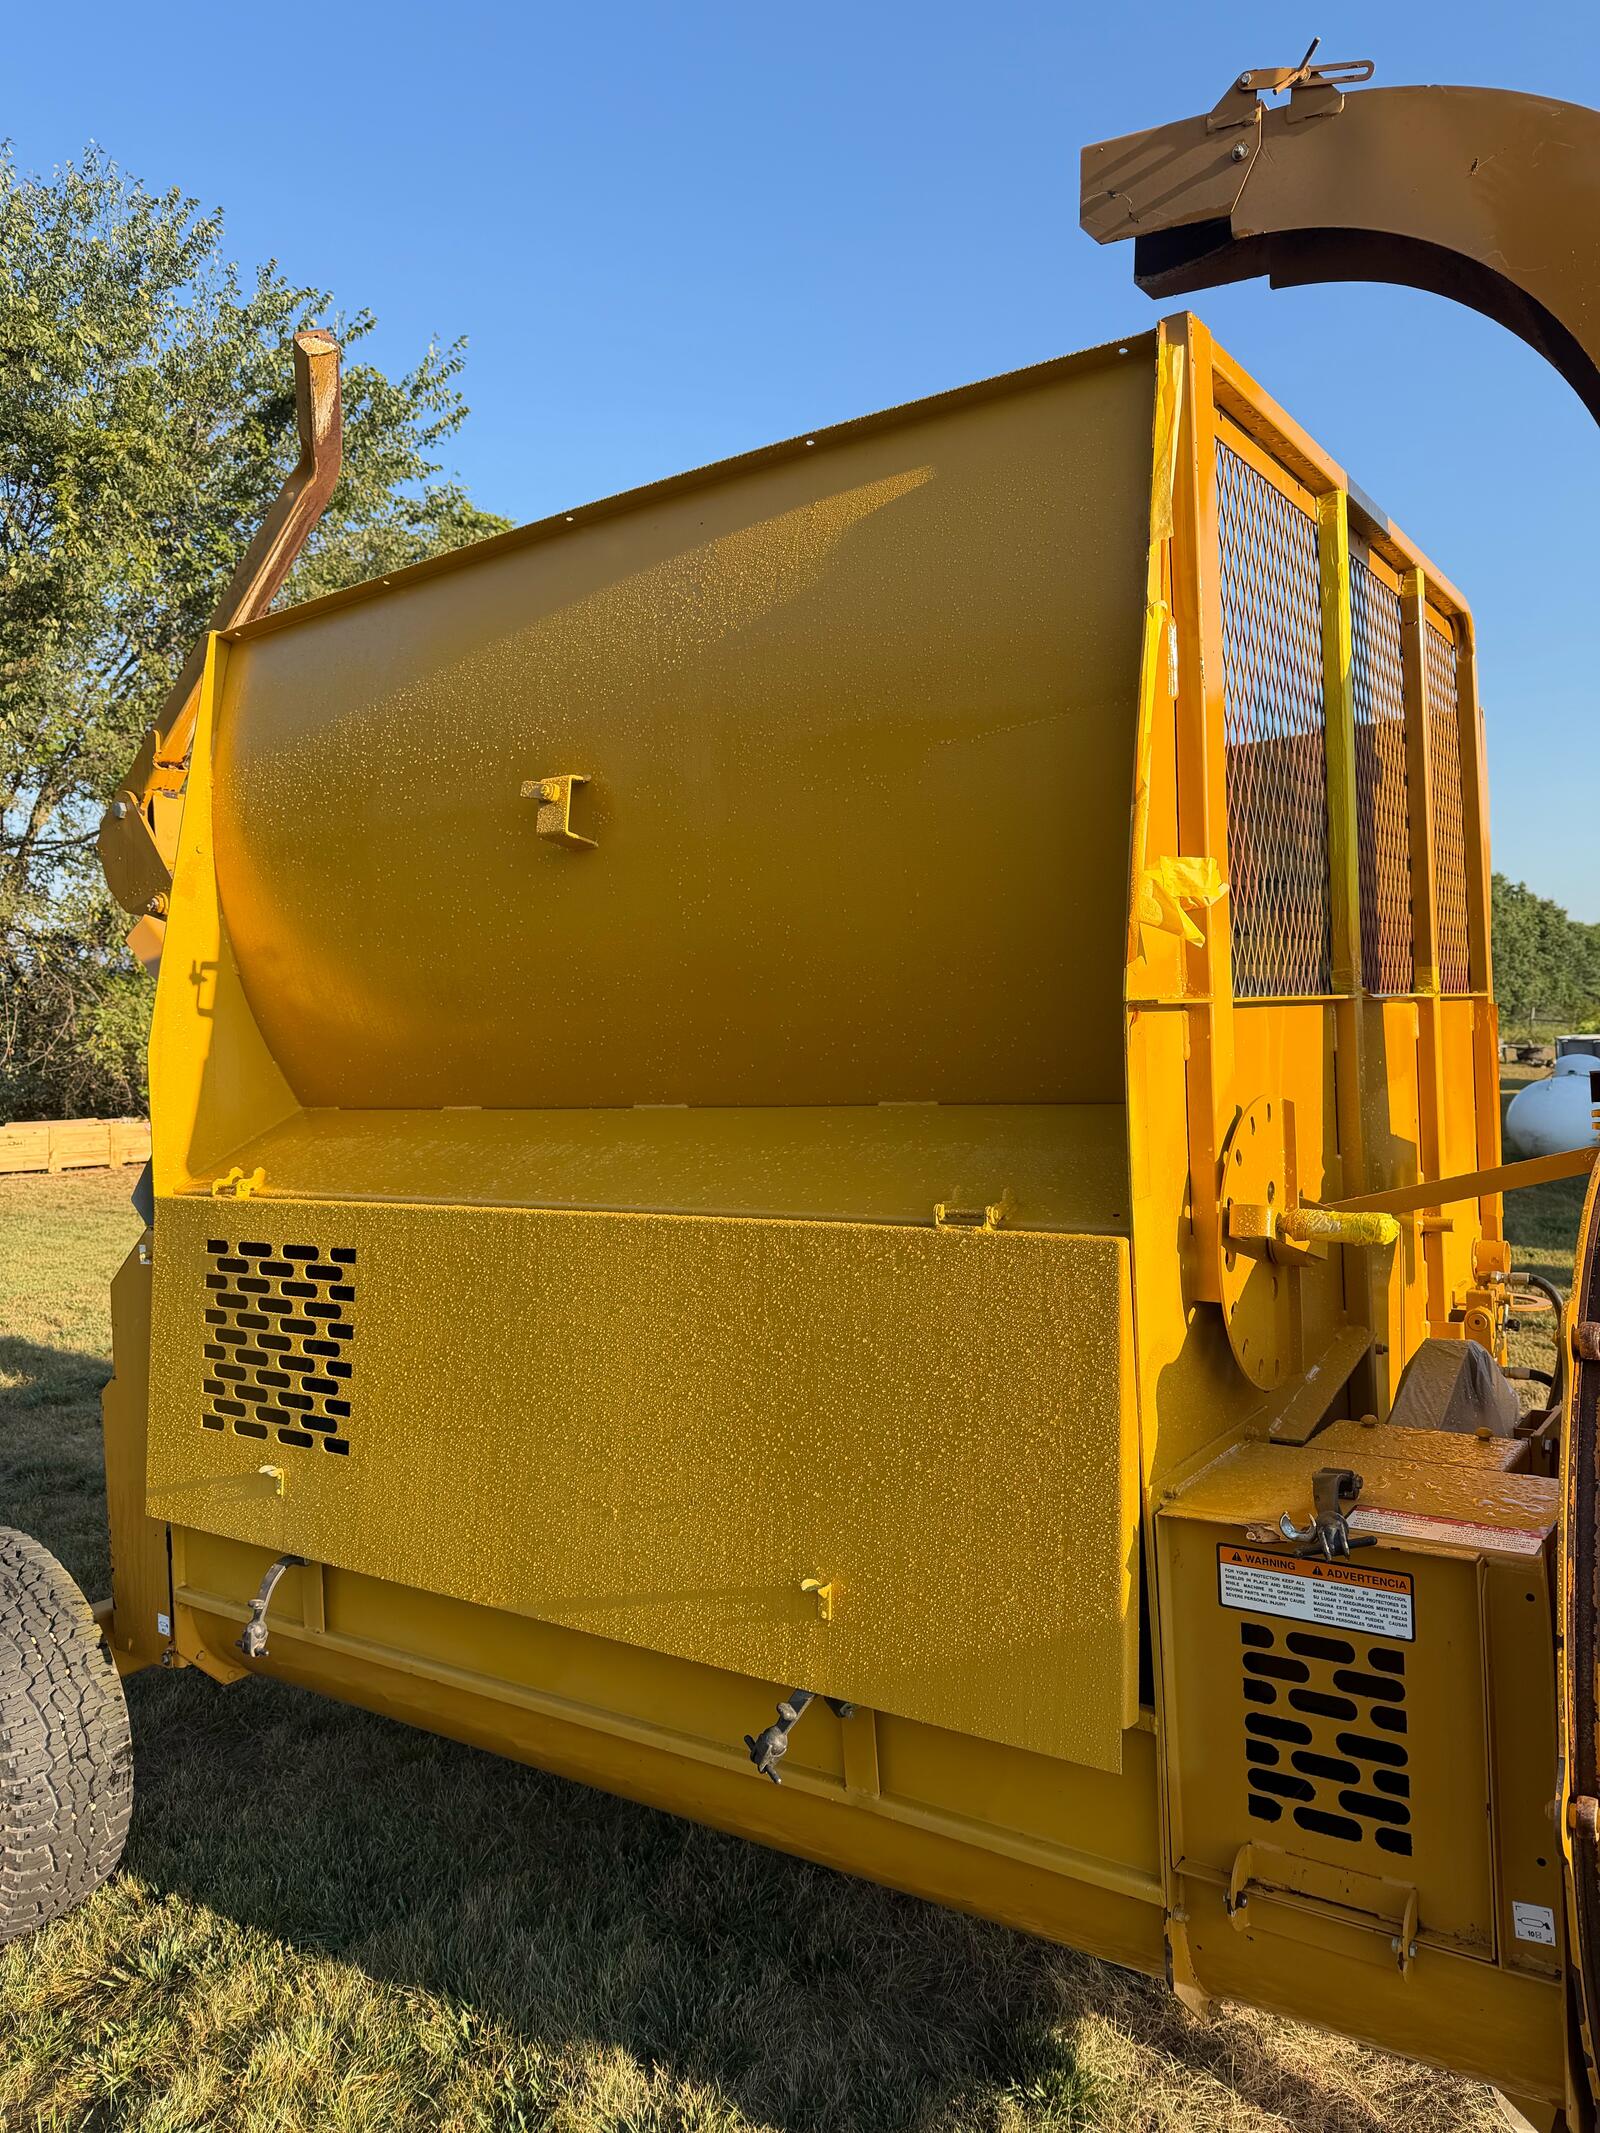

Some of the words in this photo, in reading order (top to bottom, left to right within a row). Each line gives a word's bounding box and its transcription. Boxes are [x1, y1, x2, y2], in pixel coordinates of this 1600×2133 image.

[1384, 1510, 1429, 1520] DANGER
[1245, 1554, 1296, 1570] WARNING
[1327, 1569, 1406, 1589] ADVERTENCIA
